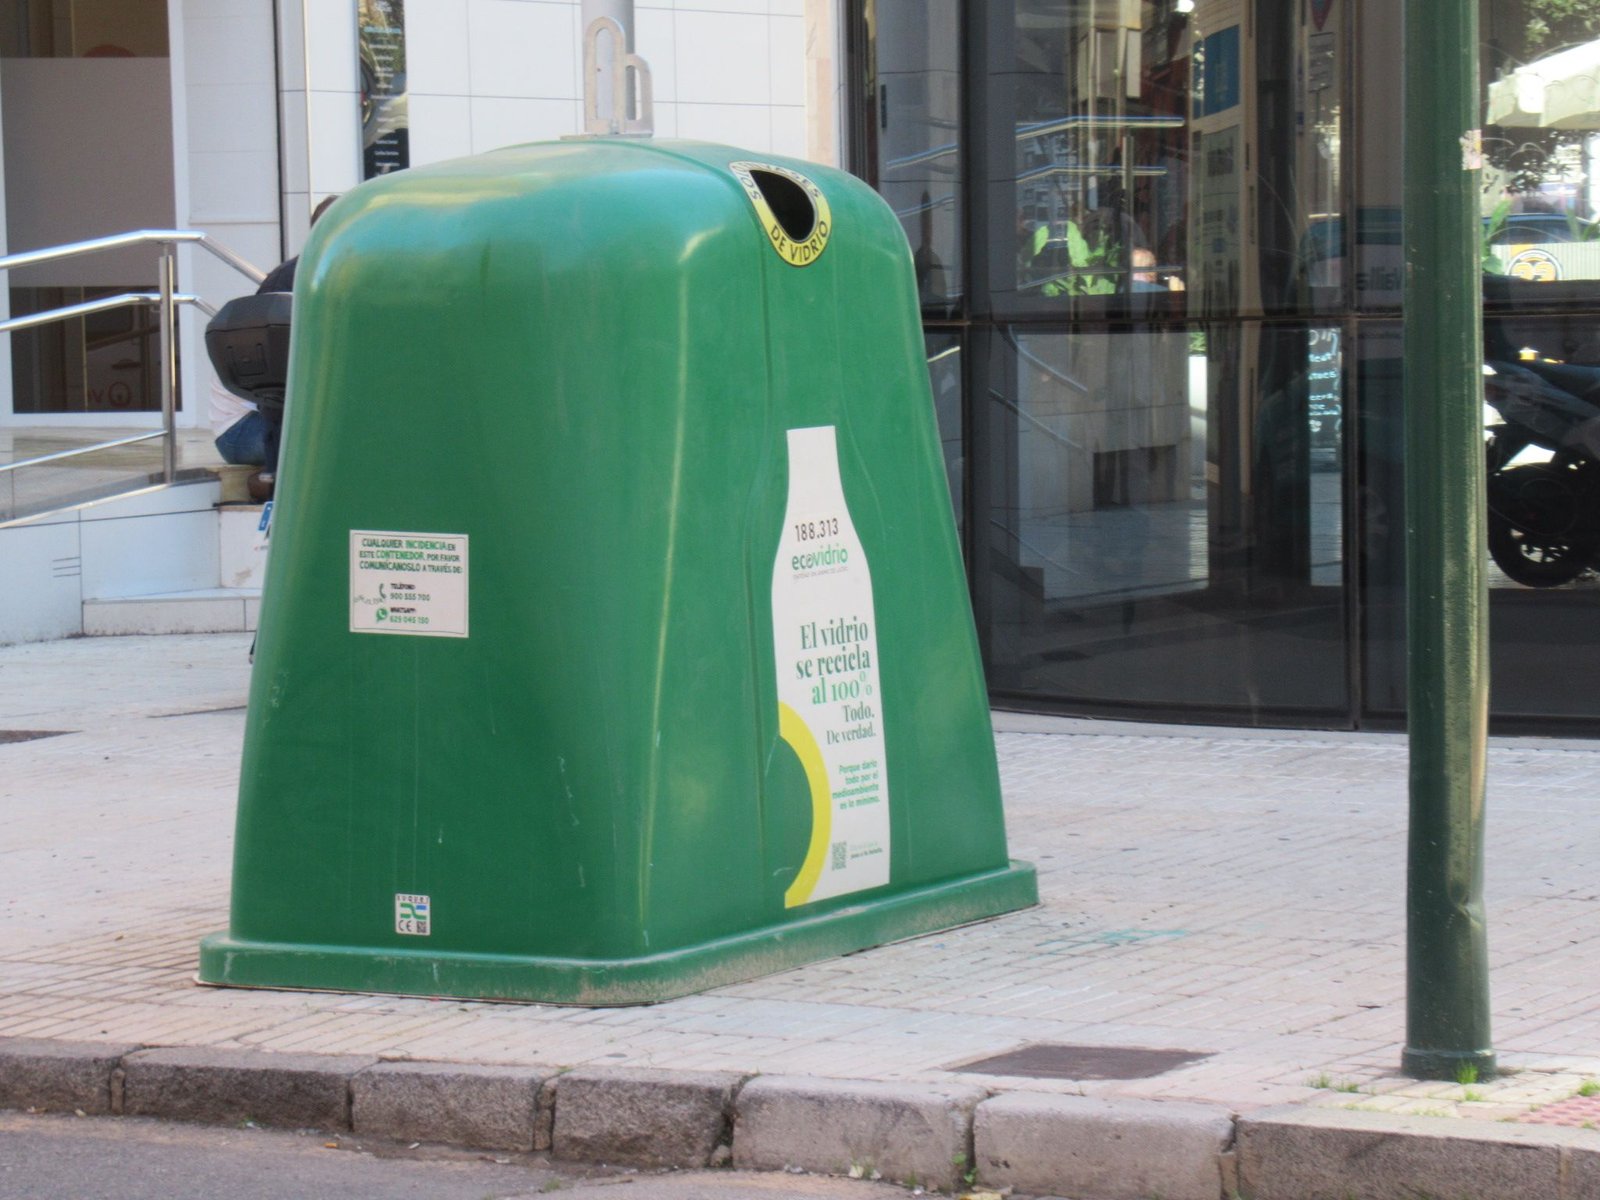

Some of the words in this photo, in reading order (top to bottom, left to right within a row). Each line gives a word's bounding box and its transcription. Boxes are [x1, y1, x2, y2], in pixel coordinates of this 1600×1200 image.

[770, 225, 787, 252] DE
[790, 220, 828, 263] VIDRIO
[795, 518, 839, 542] 188.313
[359, 550, 375, 559] ESTE
[427, 553, 440, 561] POR
[440, 554, 460, 562] FAVOR
[362, 538, 403, 549] CUALQUIER
[406, 540, 447, 550] INCIDENCIA
[428, 563, 452, 573] TRAVÉS
[791, 542, 848, 571] ecovidrio
[800, 621, 818, 650] El
[820, 615, 868, 646] vidrio
[796, 657, 813, 680] se
[817, 643, 871, 676] recicla
[812, 676, 827, 705] al
[843, 701, 875, 722] Todo.
[826, 730, 840, 745] De
[841, 721, 876, 742] verdad.
